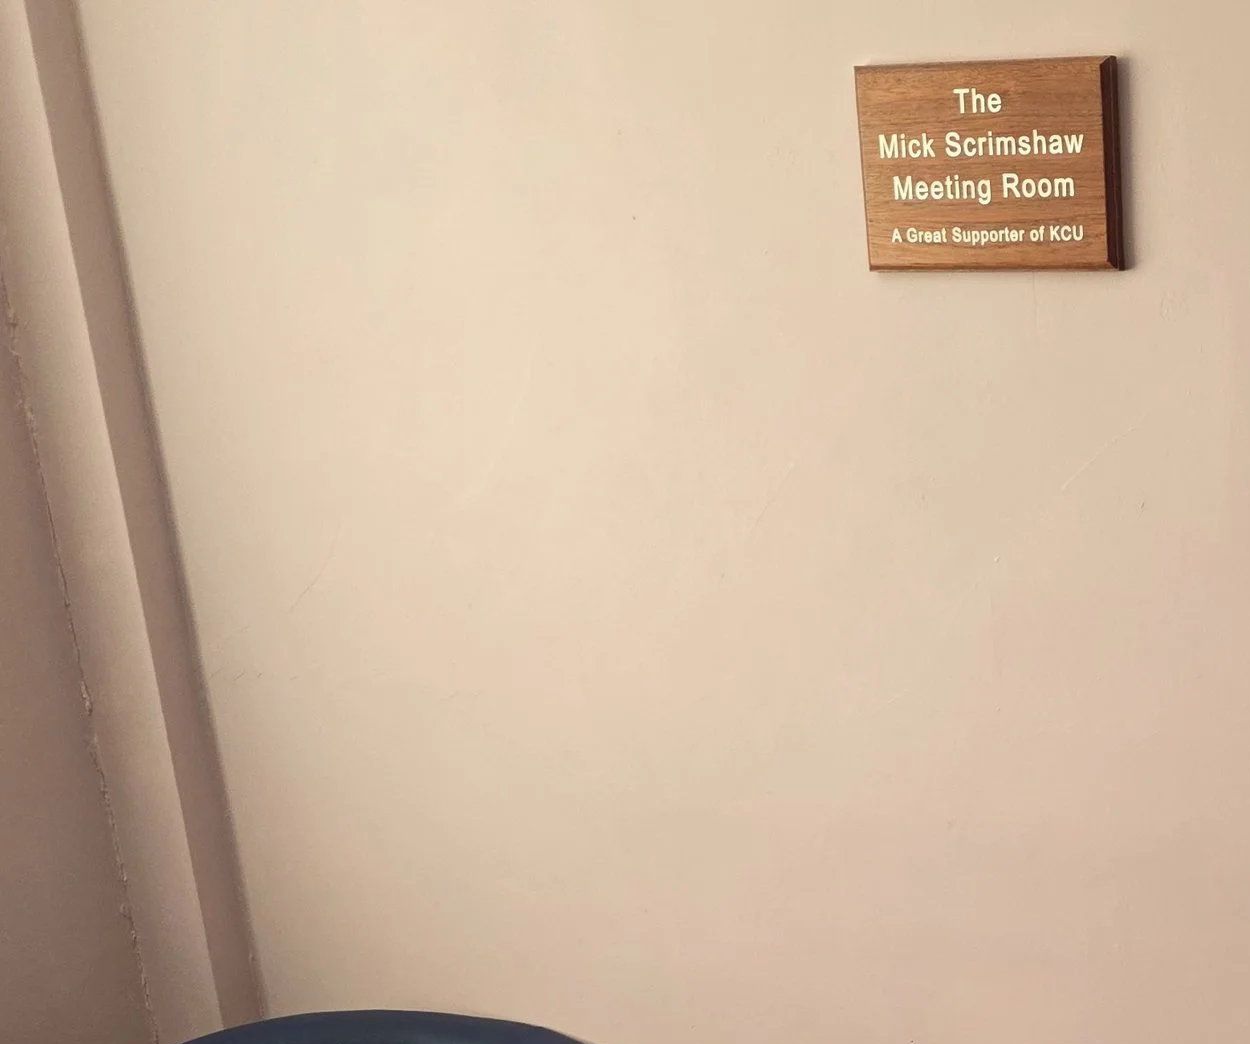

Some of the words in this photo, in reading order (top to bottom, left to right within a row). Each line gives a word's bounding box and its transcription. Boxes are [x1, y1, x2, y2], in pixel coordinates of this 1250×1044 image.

[953, 88, 1002, 113] The
[878, 133, 936, 158] Mick
[945, 129, 1084, 157] Scrimshaw
[893, 175, 992, 205] Meeting
[1002, 173, 1075, 198] Room
[892, 228, 903, 243] A
[906, 228, 947, 243] Great
[952, 226, 1025, 245] Supporter
[1030, 225, 1044, 242] of
[1049, 225, 1084, 241] KCU
